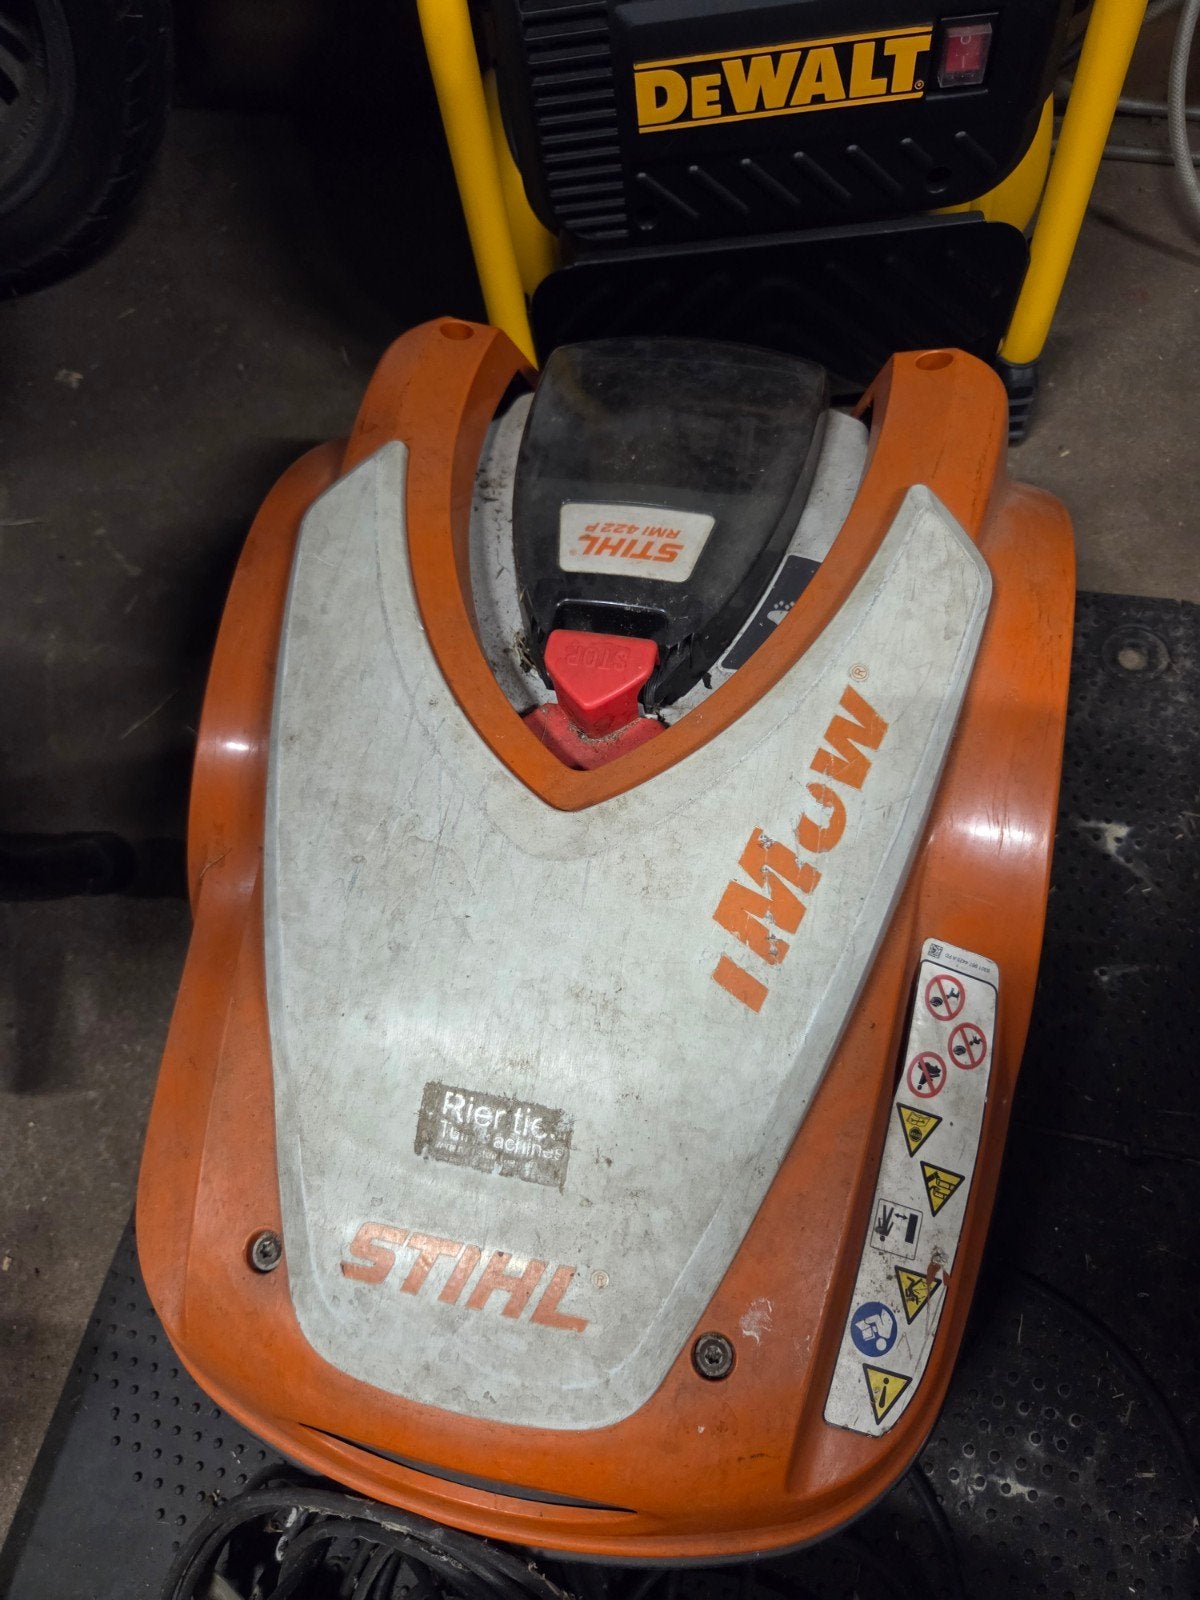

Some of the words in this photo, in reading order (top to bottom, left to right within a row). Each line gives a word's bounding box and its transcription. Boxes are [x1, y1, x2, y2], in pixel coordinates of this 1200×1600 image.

[584, 522, 600, 532] P
[600, 522, 641, 535] 422
[642, 524, 682, 539] RMI
[578, 534, 685, 563] STIHL
[565, 643, 631, 672] STOP
[340, 1221, 590, 1333] STIHL
